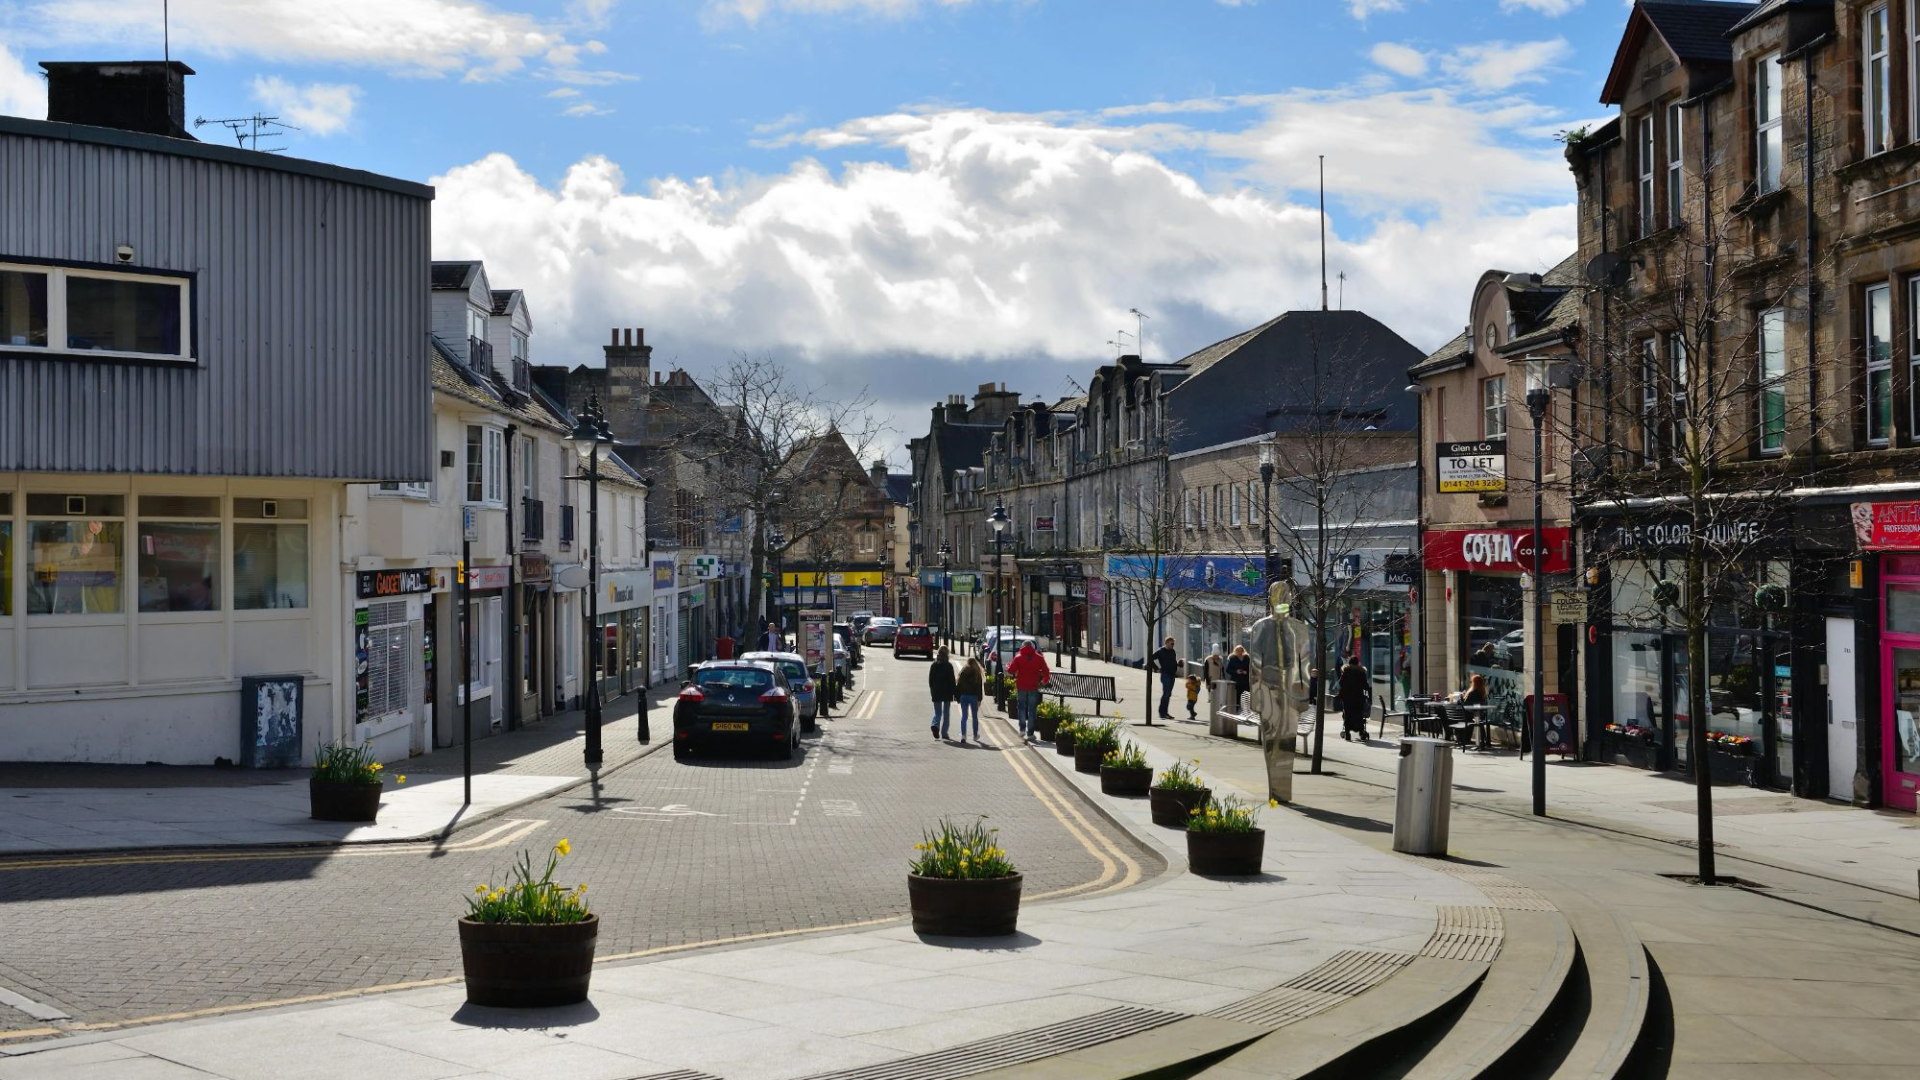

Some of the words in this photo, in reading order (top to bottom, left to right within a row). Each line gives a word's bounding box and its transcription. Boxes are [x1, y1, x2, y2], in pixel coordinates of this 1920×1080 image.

[1450, 444, 1471, 452] Glen
[1478, 443, 1491, 451] Co
[1449, 458, 1467, 470] TO
[1472, 457, 1494, 469] LET
[1443, 480, 1463, 488] 0141
[1464, 480, 1480, 488] 204
[1877, 504, 1920, 523] ANTH
[1462, 533, 1513, 567] COSTA
[1388, 573, 1412, 583] M&Co
